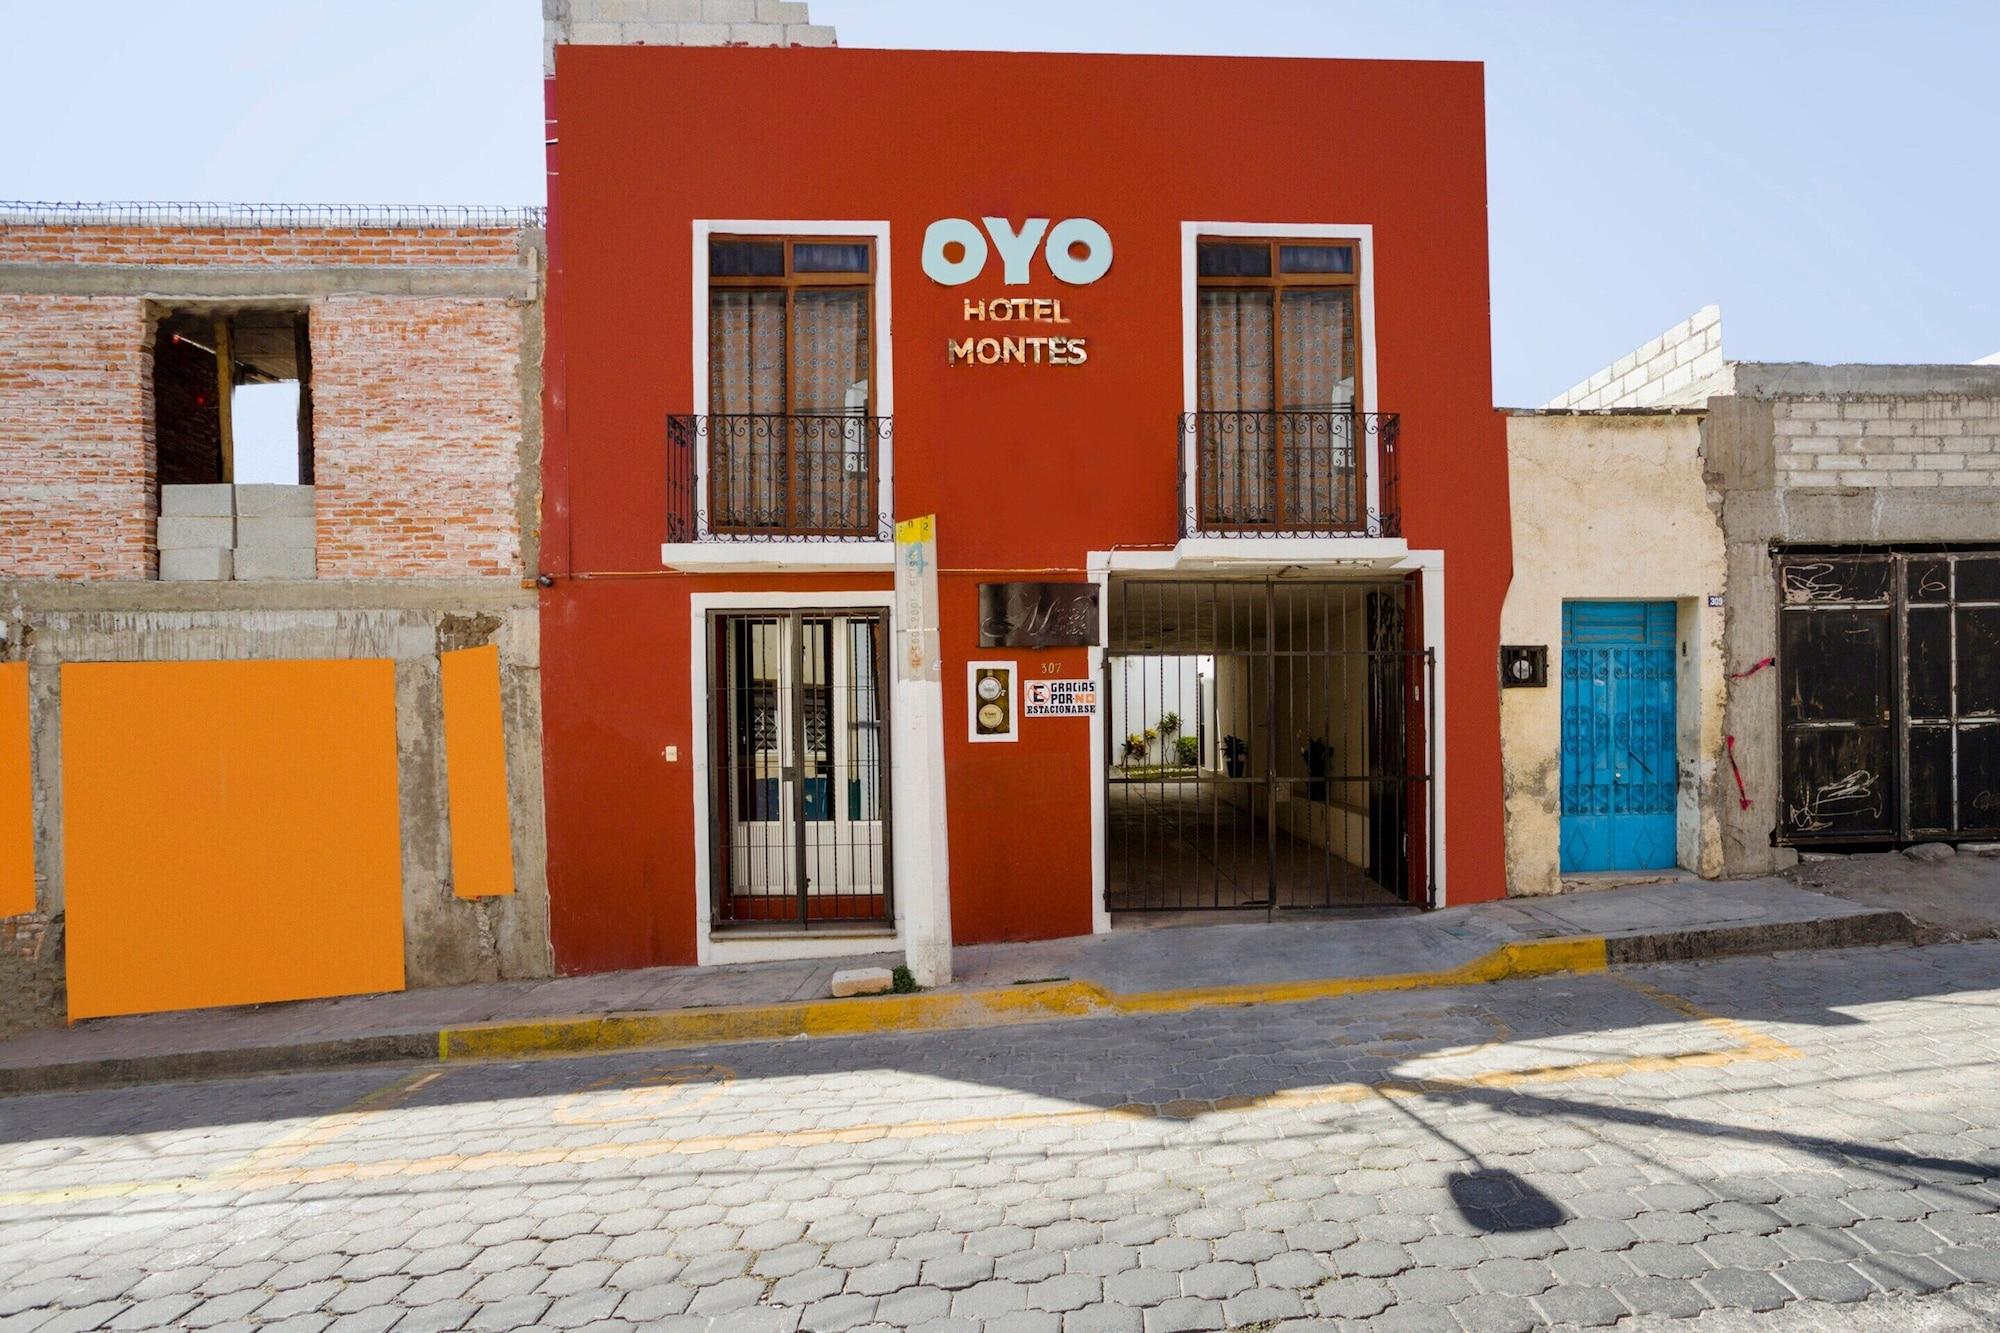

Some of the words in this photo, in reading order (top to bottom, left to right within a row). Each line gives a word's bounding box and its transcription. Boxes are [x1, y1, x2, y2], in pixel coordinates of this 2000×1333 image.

[921, 216, 1114, 286] OYO
[963, 297, 1071, 324] HOTEL
[948, 335, 1088, 366] MONTES
[1041, 662, 1062, 674] 307
[1075, 693, 1095, 703] NO
[1027, 705, 1096, 714] ESTACIONARSE
